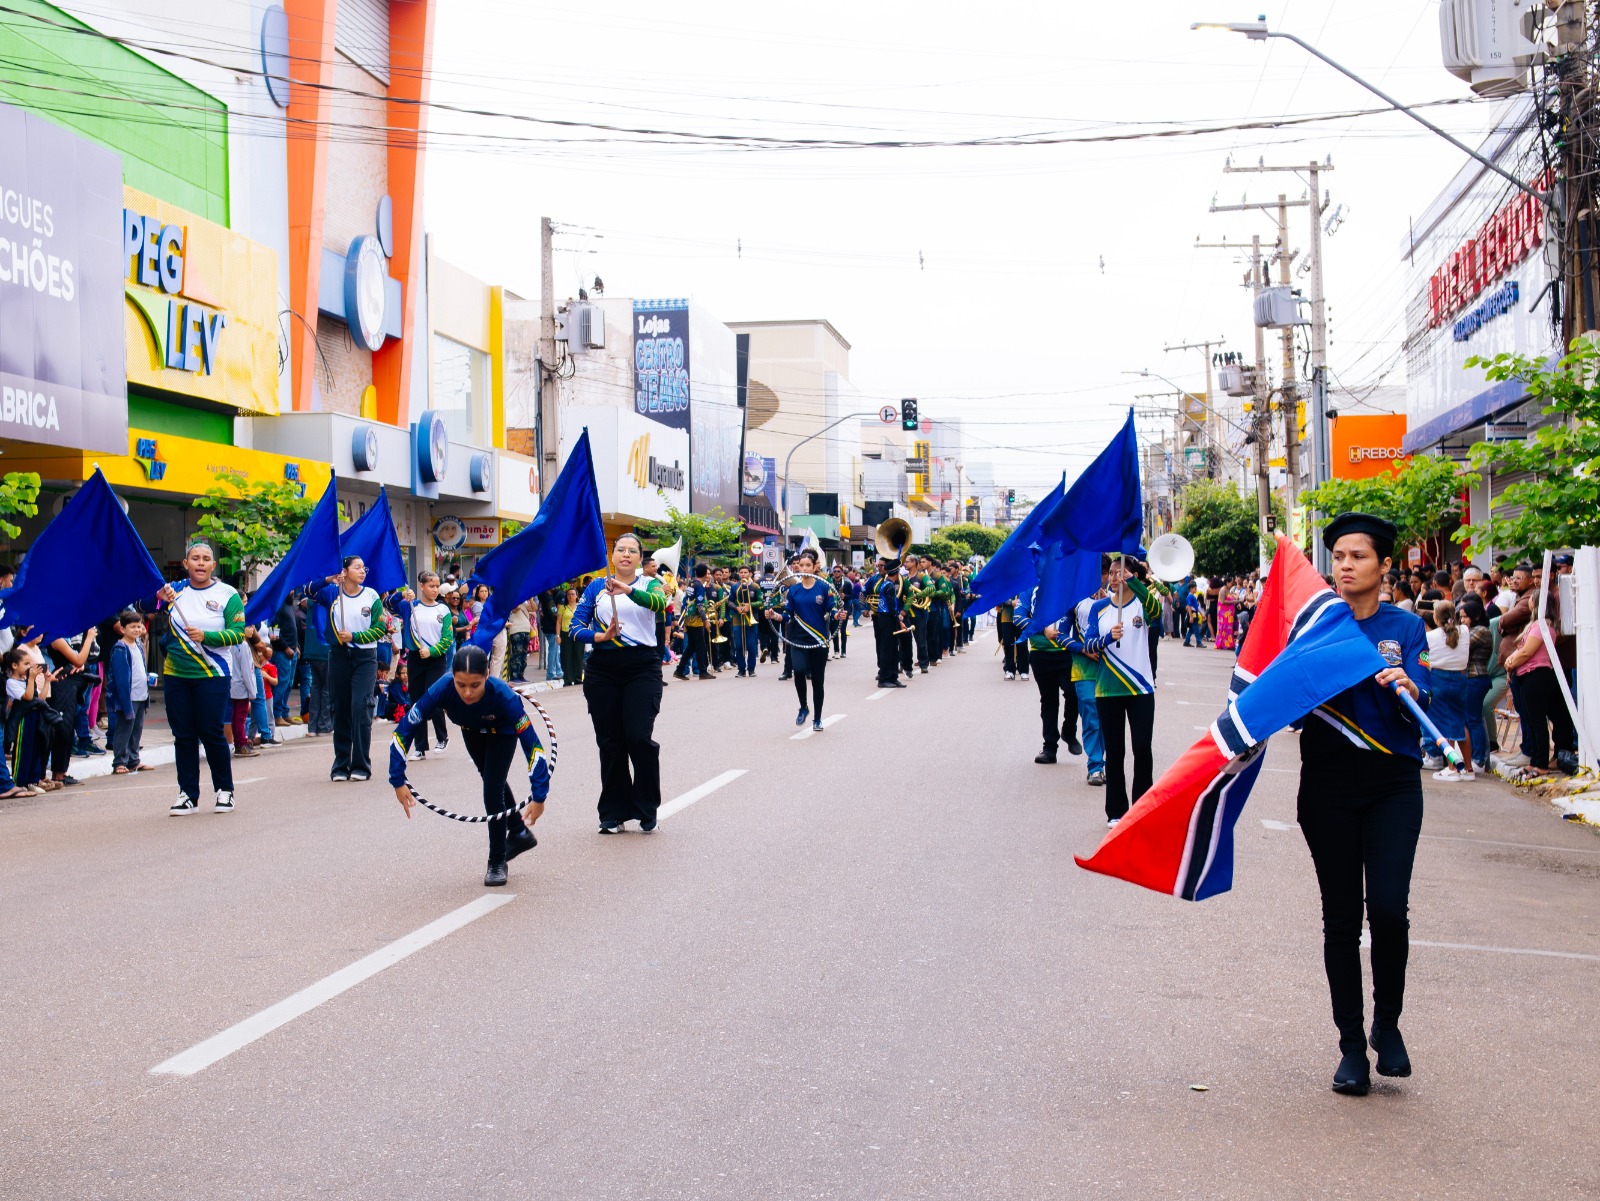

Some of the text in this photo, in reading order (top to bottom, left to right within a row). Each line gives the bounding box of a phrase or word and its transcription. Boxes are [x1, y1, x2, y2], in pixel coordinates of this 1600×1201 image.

[1490, 51, 1502, 59] 150
[0, 237, 75, 301] CHÕES
[123, 208, 183, 294] PEG
[166, 300, 224, 376] LEV
[638, 315, 670, 338] Lojas
[635, 337, 684, 371] CENTRO
[0, 386, 60, 431] BRICA
[637, 369, 689, 414] JEANS
[137, 438, 157, 459] PEG
[150, 460, 167, 480] LEV
